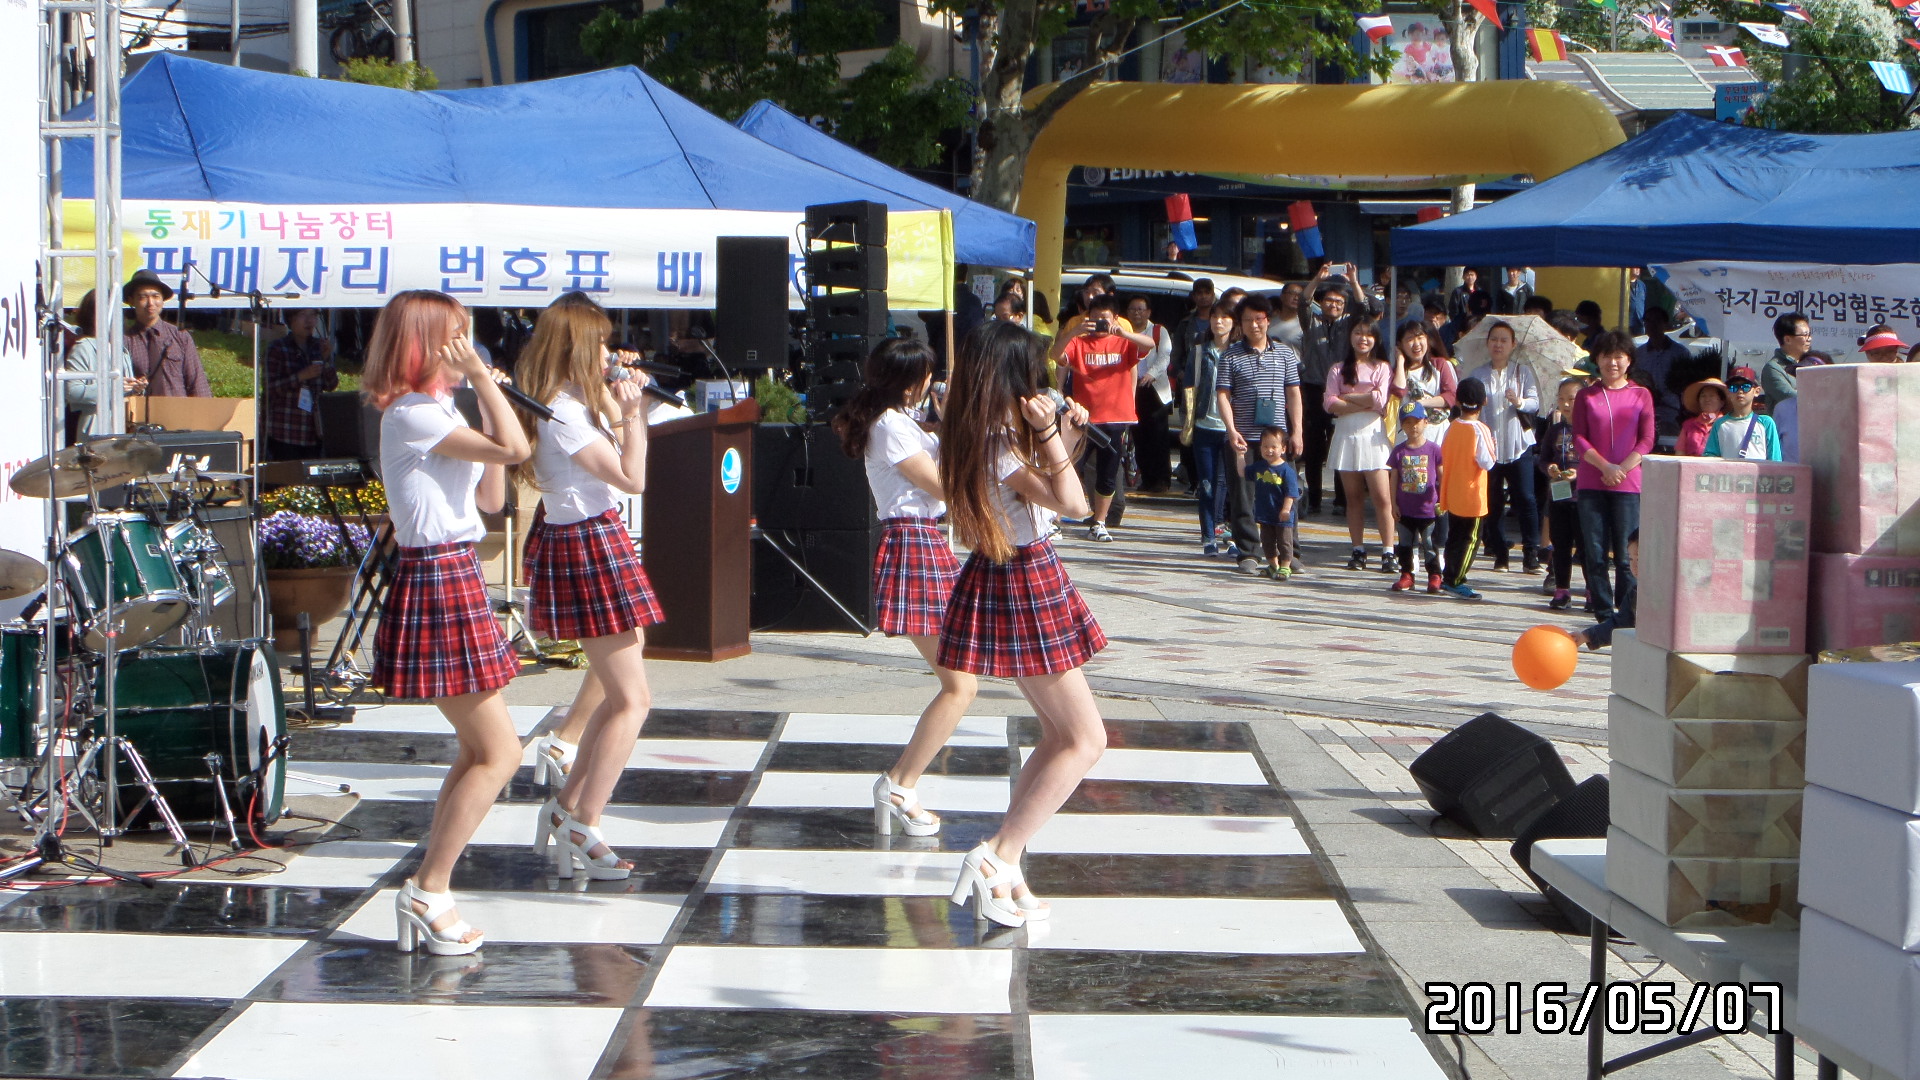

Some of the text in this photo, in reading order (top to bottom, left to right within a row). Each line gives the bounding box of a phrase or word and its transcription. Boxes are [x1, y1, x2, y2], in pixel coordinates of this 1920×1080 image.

[145, 209, 393, 240] 동재기 나눔장터
[142, 246, 389, 296] 판매자리
[439, 245, 610, 293] 번호표
